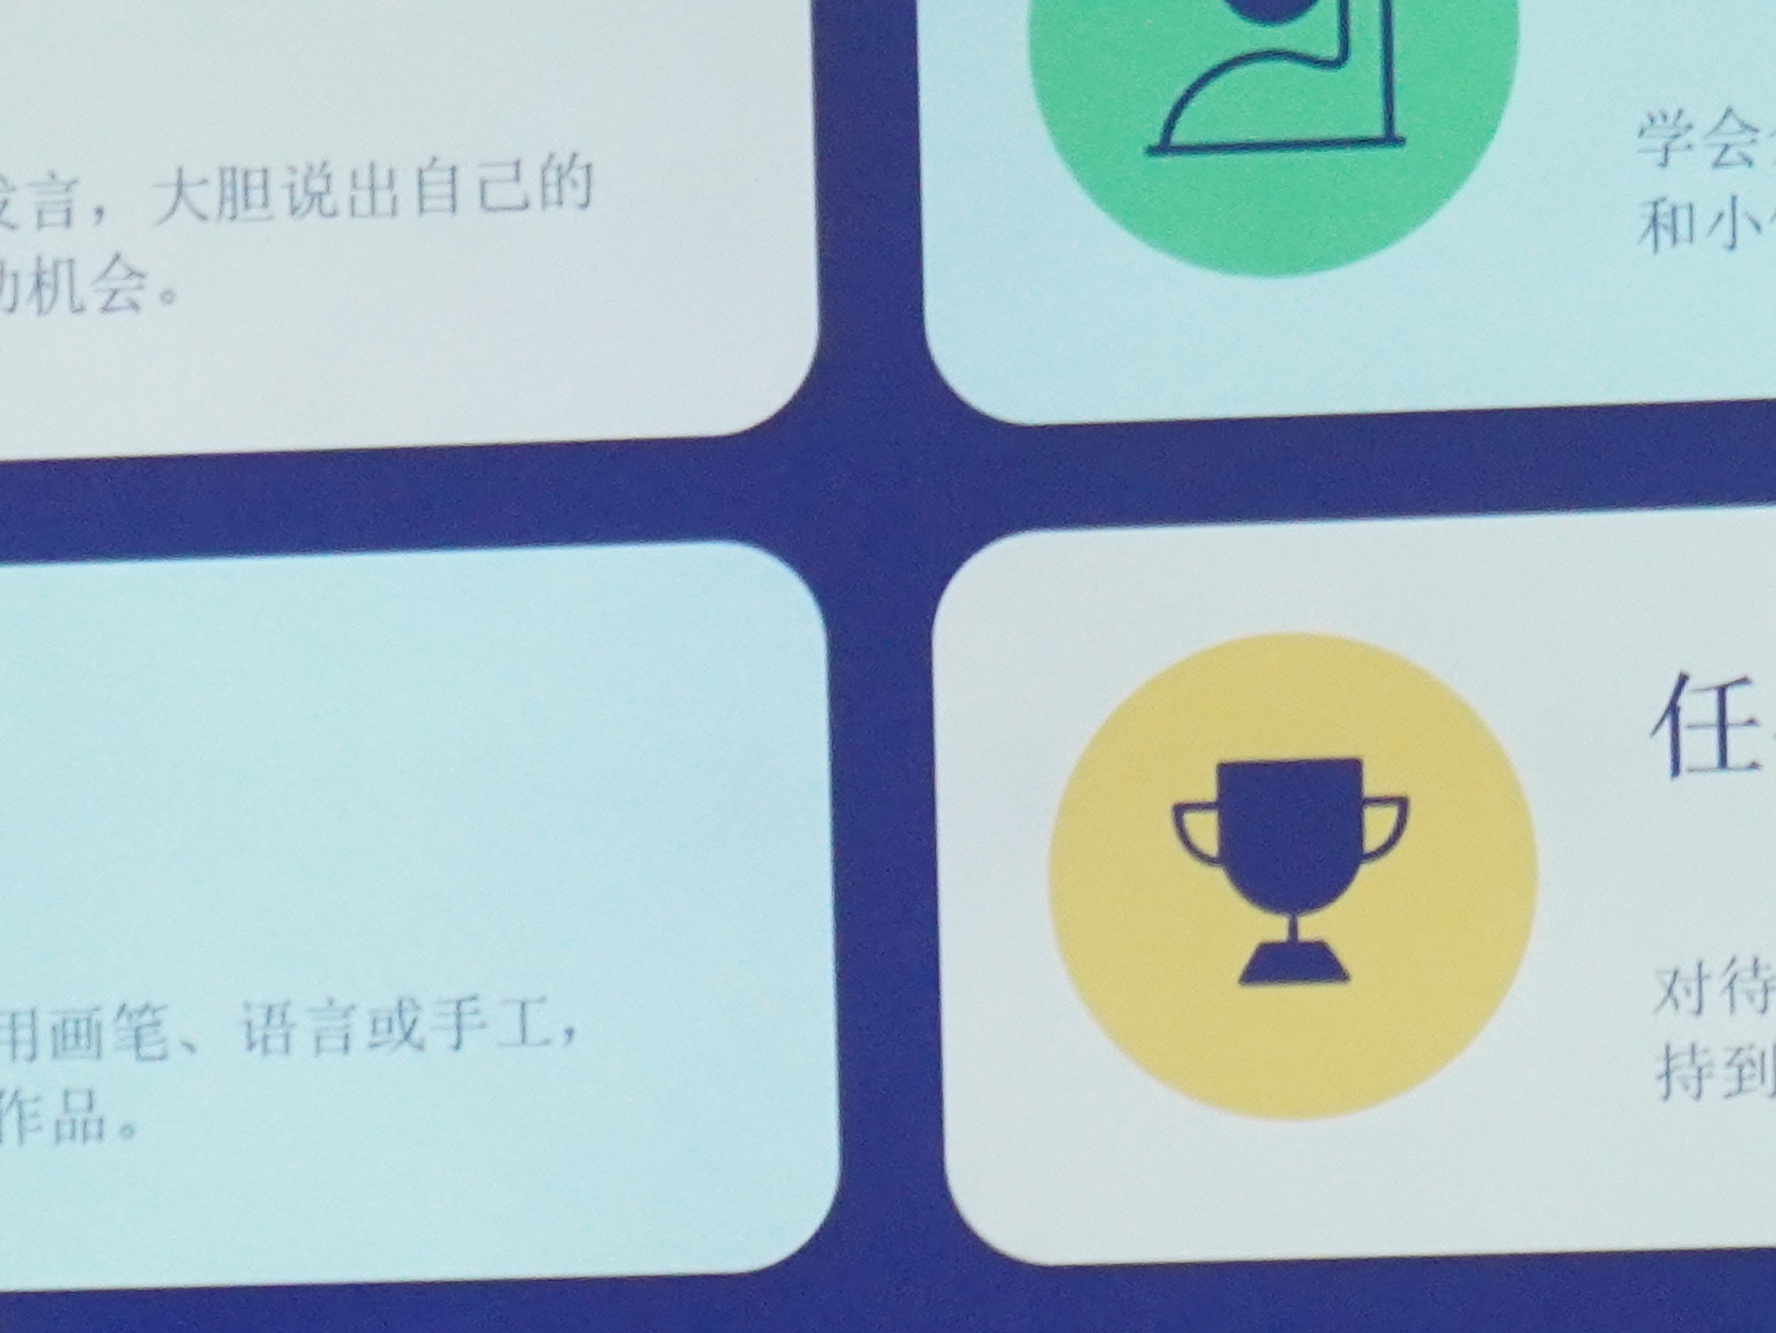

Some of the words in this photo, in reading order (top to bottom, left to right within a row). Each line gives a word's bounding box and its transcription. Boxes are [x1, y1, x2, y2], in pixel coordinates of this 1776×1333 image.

[1638, 104, 1776, 170] 学会
[1638, 193, 1776, 256] 和小
[1653, 953, 1776, 1018] 对待
[1656, 1041, 1776, 1102] 持到
